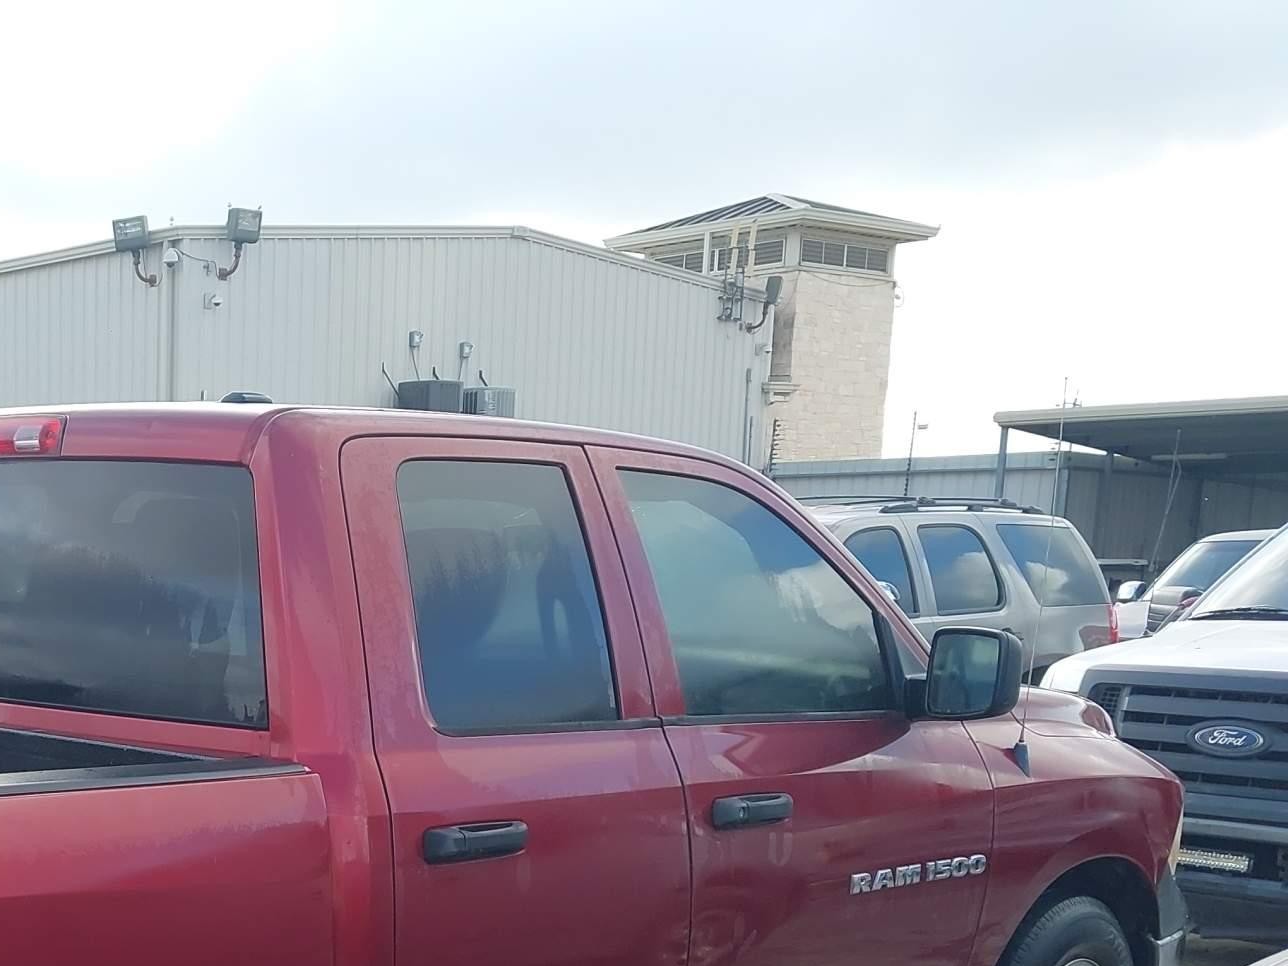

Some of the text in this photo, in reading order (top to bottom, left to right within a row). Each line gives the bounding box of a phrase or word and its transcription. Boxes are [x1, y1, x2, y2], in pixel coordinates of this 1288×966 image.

[1208, 729, 1248, 746] Ford
[849, 853, 988, 896] RAM 1500
